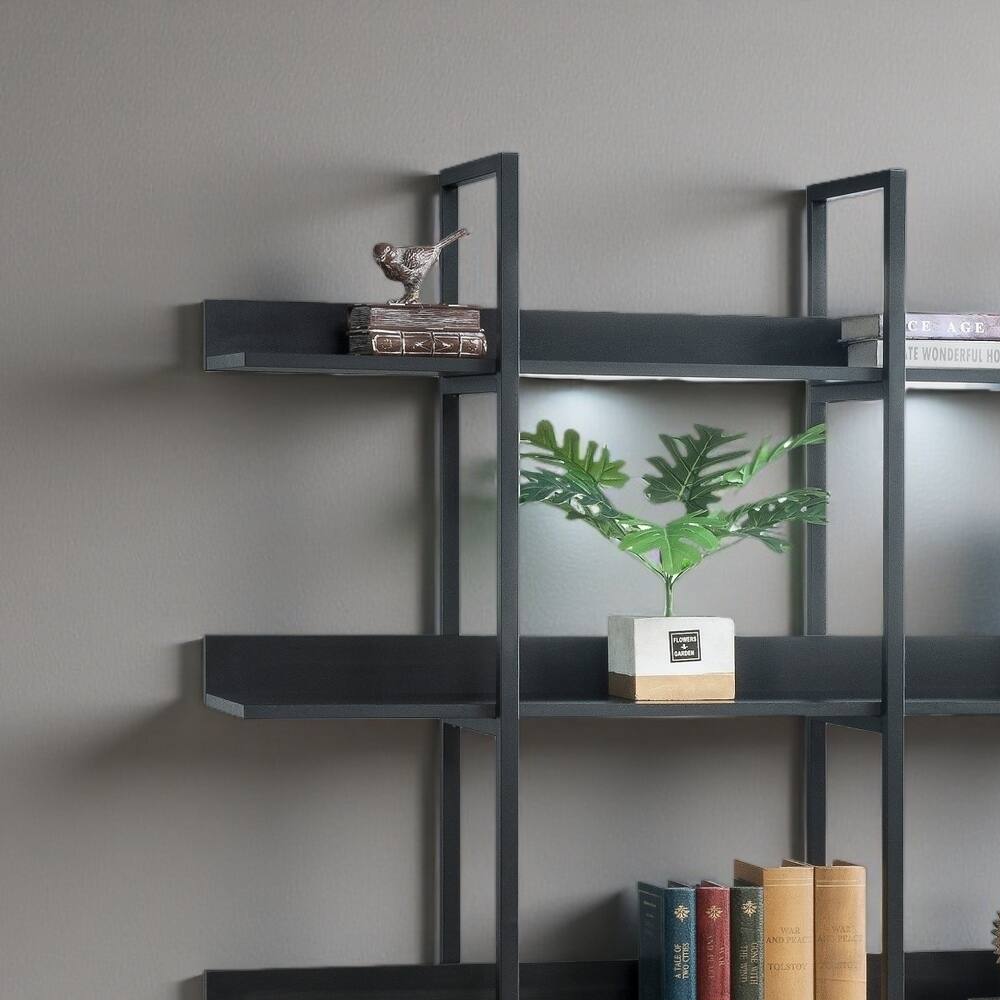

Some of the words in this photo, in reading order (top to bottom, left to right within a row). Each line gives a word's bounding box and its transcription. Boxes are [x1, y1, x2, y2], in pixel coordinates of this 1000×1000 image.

[947, 321, 986, 334] AGE
[921, 346, 983, 363] WONDERFUL
[779, 927, 801, 935] WAR
[765, 936, 784, 944] AND
[673, 943, 682, 953] OF
[682, 942, 691, 963] CITIES
[673, 954, 682, 972] TALE
[767, 962, 808, 971] TOLSTOY
[682, 964, 690, 980] TWO
[750, 965, 759, 985] WITH
